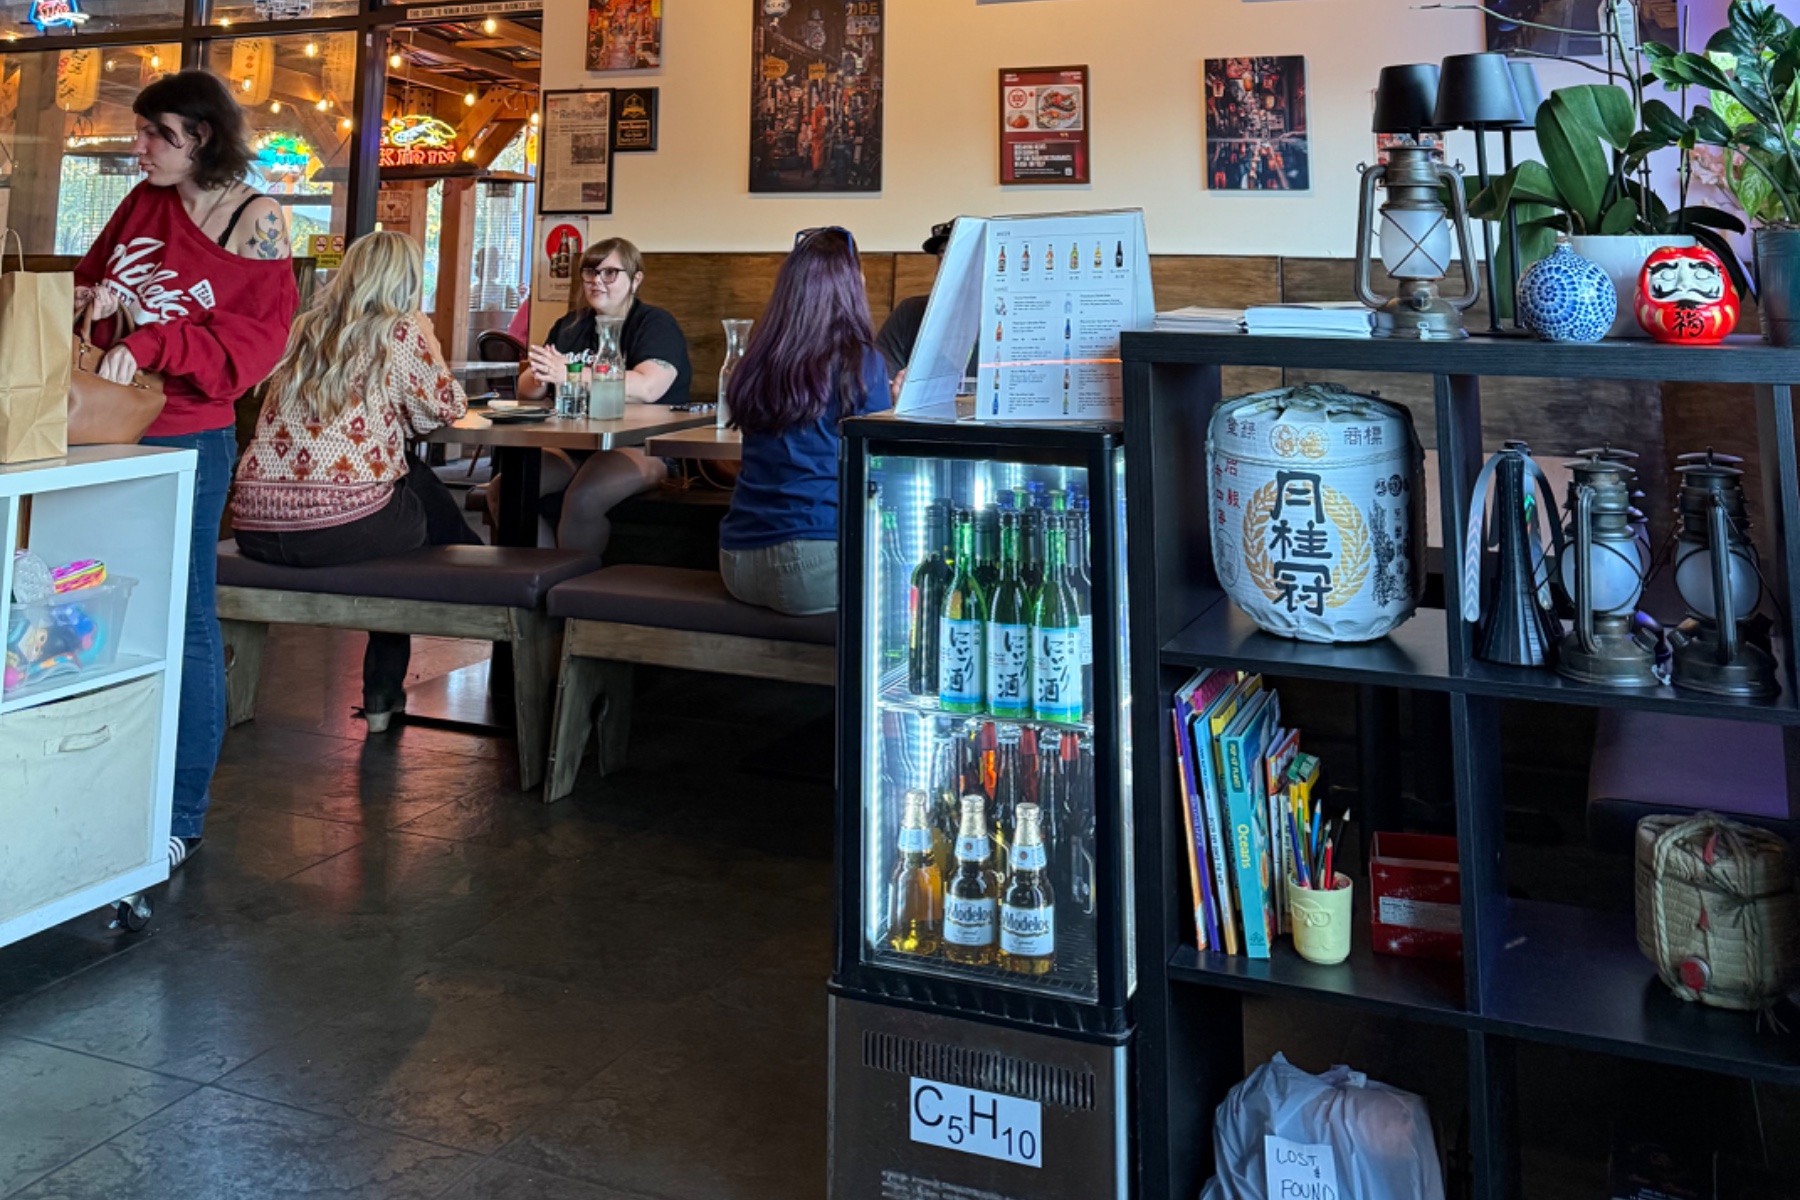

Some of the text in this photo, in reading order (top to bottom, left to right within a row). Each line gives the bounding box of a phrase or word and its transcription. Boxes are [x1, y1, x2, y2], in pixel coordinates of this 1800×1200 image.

[378, 145, 457, 167] KIRIN
[1672, 311, 1704, 338] 福
[1344, 425, 1383, 446] 商標
[1269, 470, 1334, 617] 月桂冠
[1038, 634, 1071, 703] にごり酒
[1237, 823, 1251, 869] Oceans
[1276, 1147, 1318, 1167] LOST
[1281, 1178, 1336, 1200] FOUND
